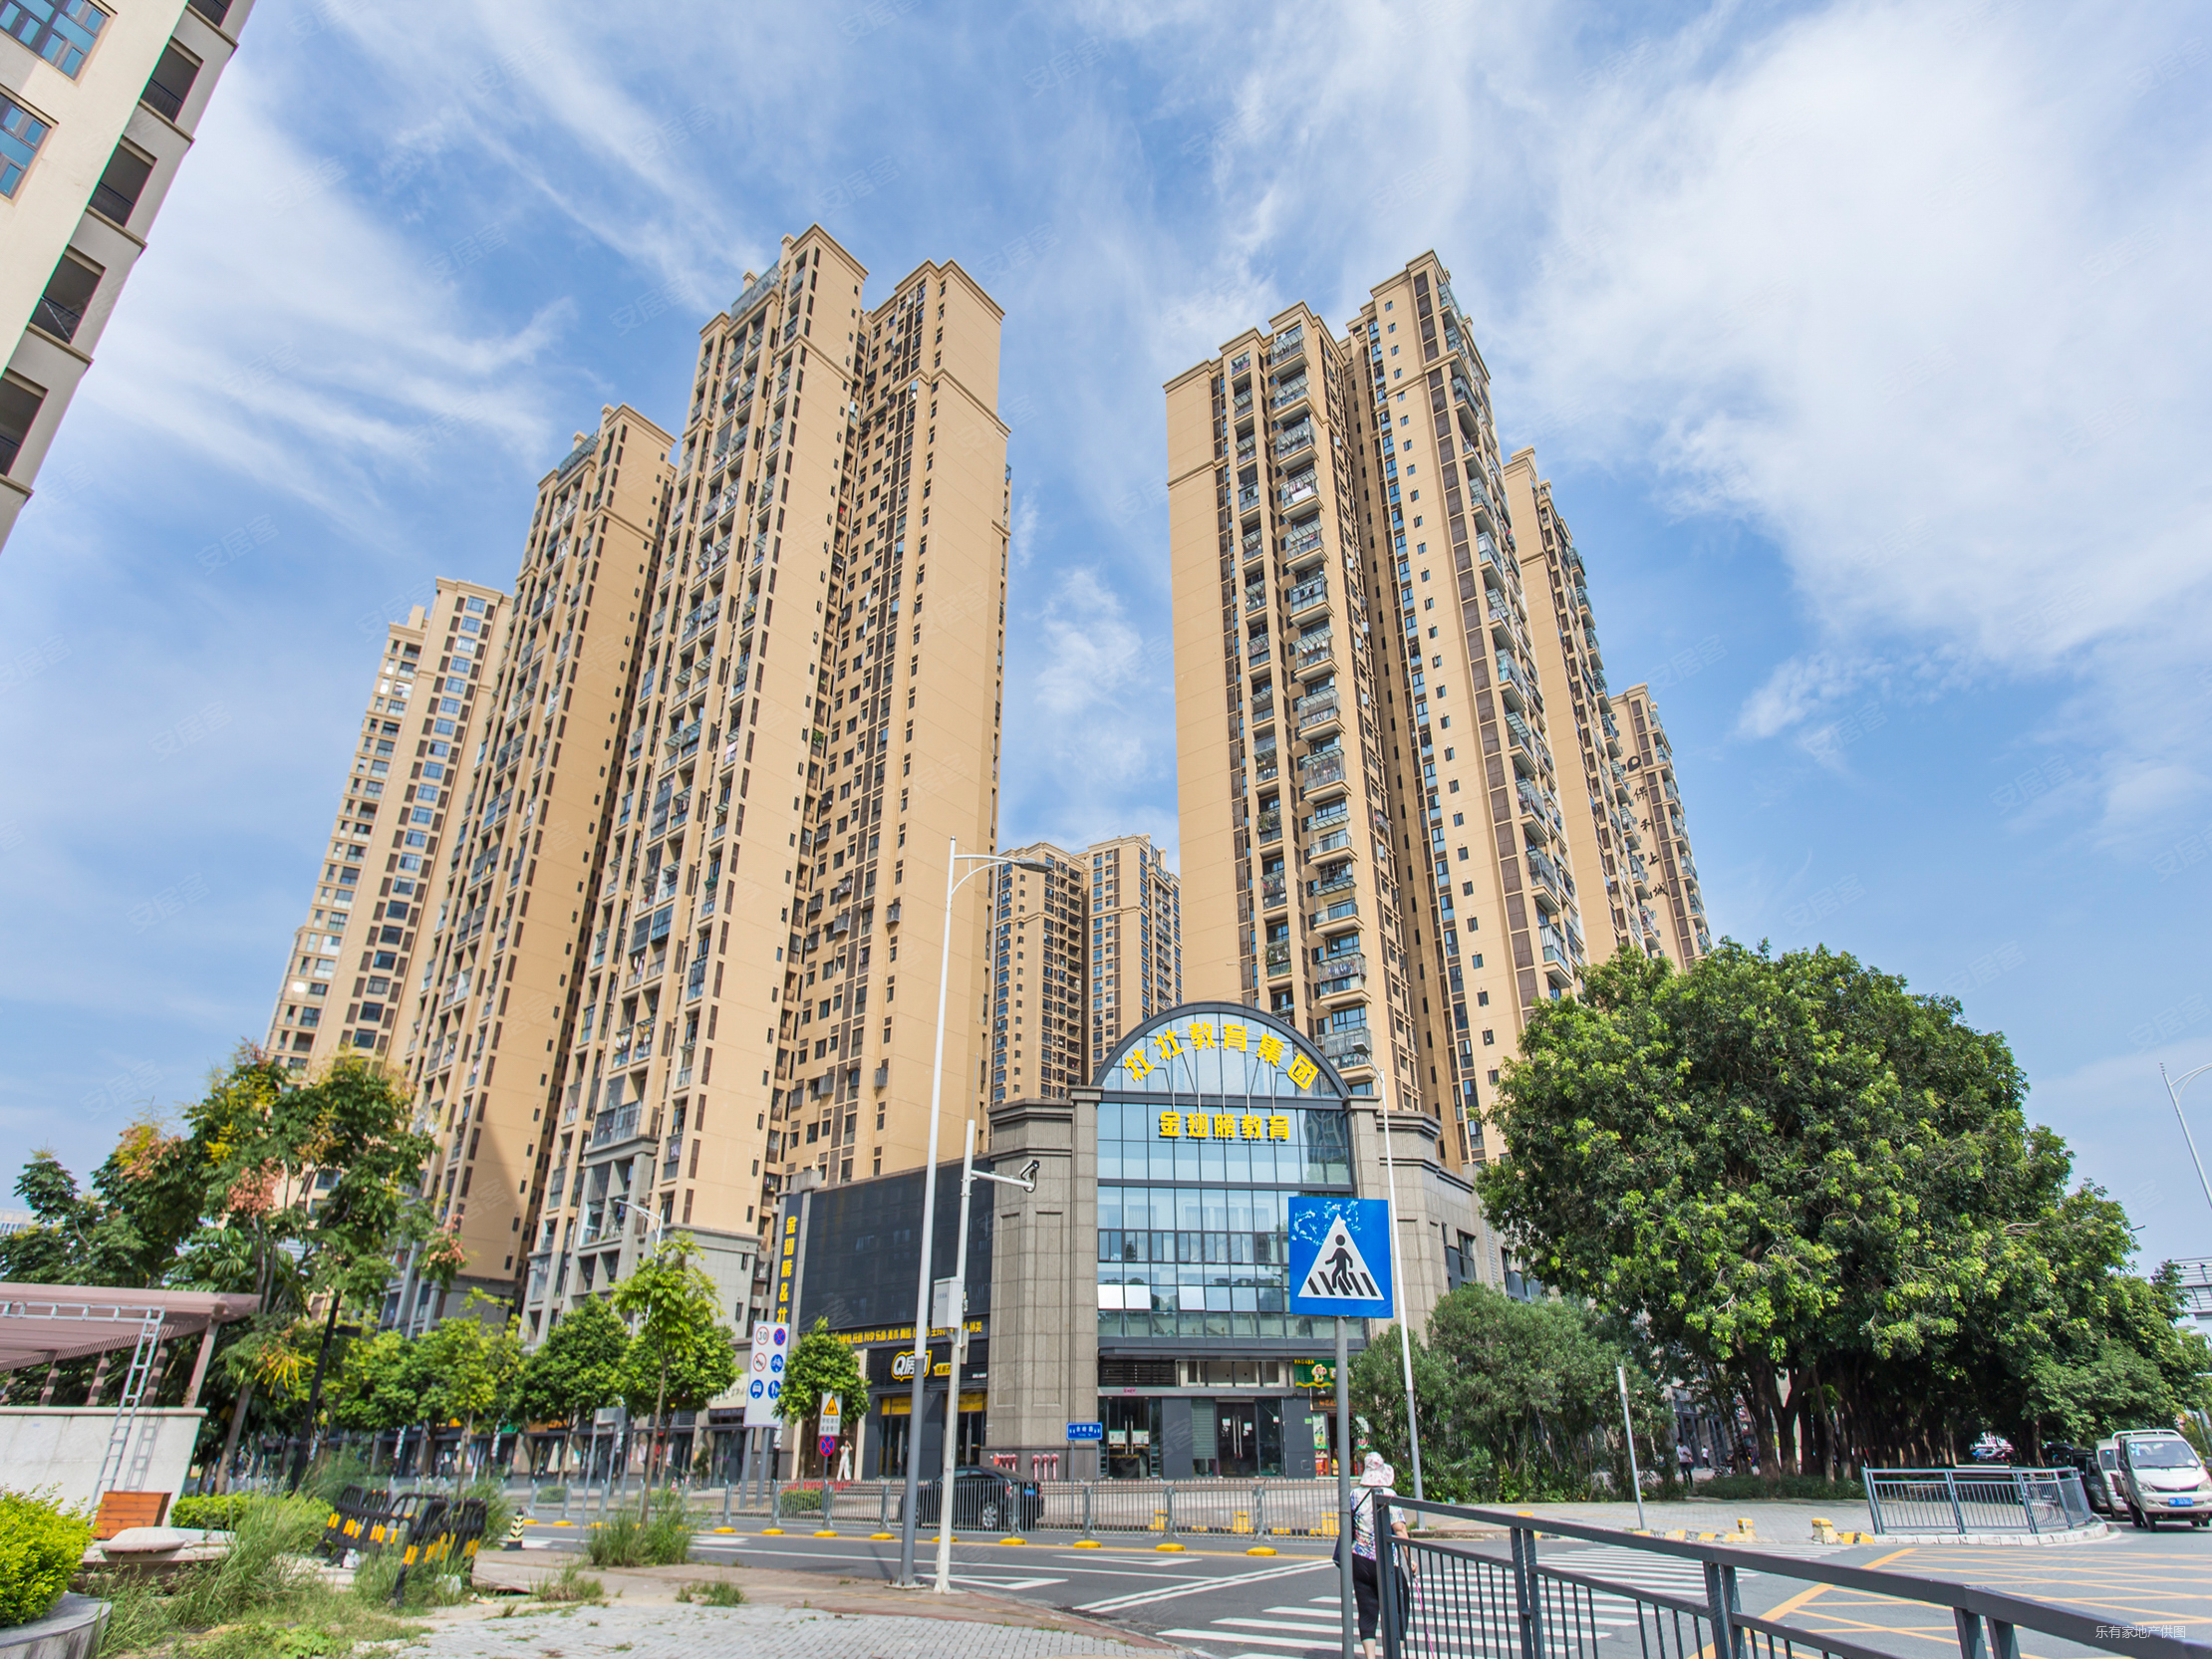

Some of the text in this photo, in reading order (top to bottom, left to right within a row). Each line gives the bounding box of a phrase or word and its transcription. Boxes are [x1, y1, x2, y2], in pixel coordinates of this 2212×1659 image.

[1633, 786, 1669, 897] 保利上城
[1124, 1021, 1319, 1090] 壮壮教育集团
[1159, 1111, 1289, 1140] 金翅膀教育
[758, 1331, 768, 1340] 30
